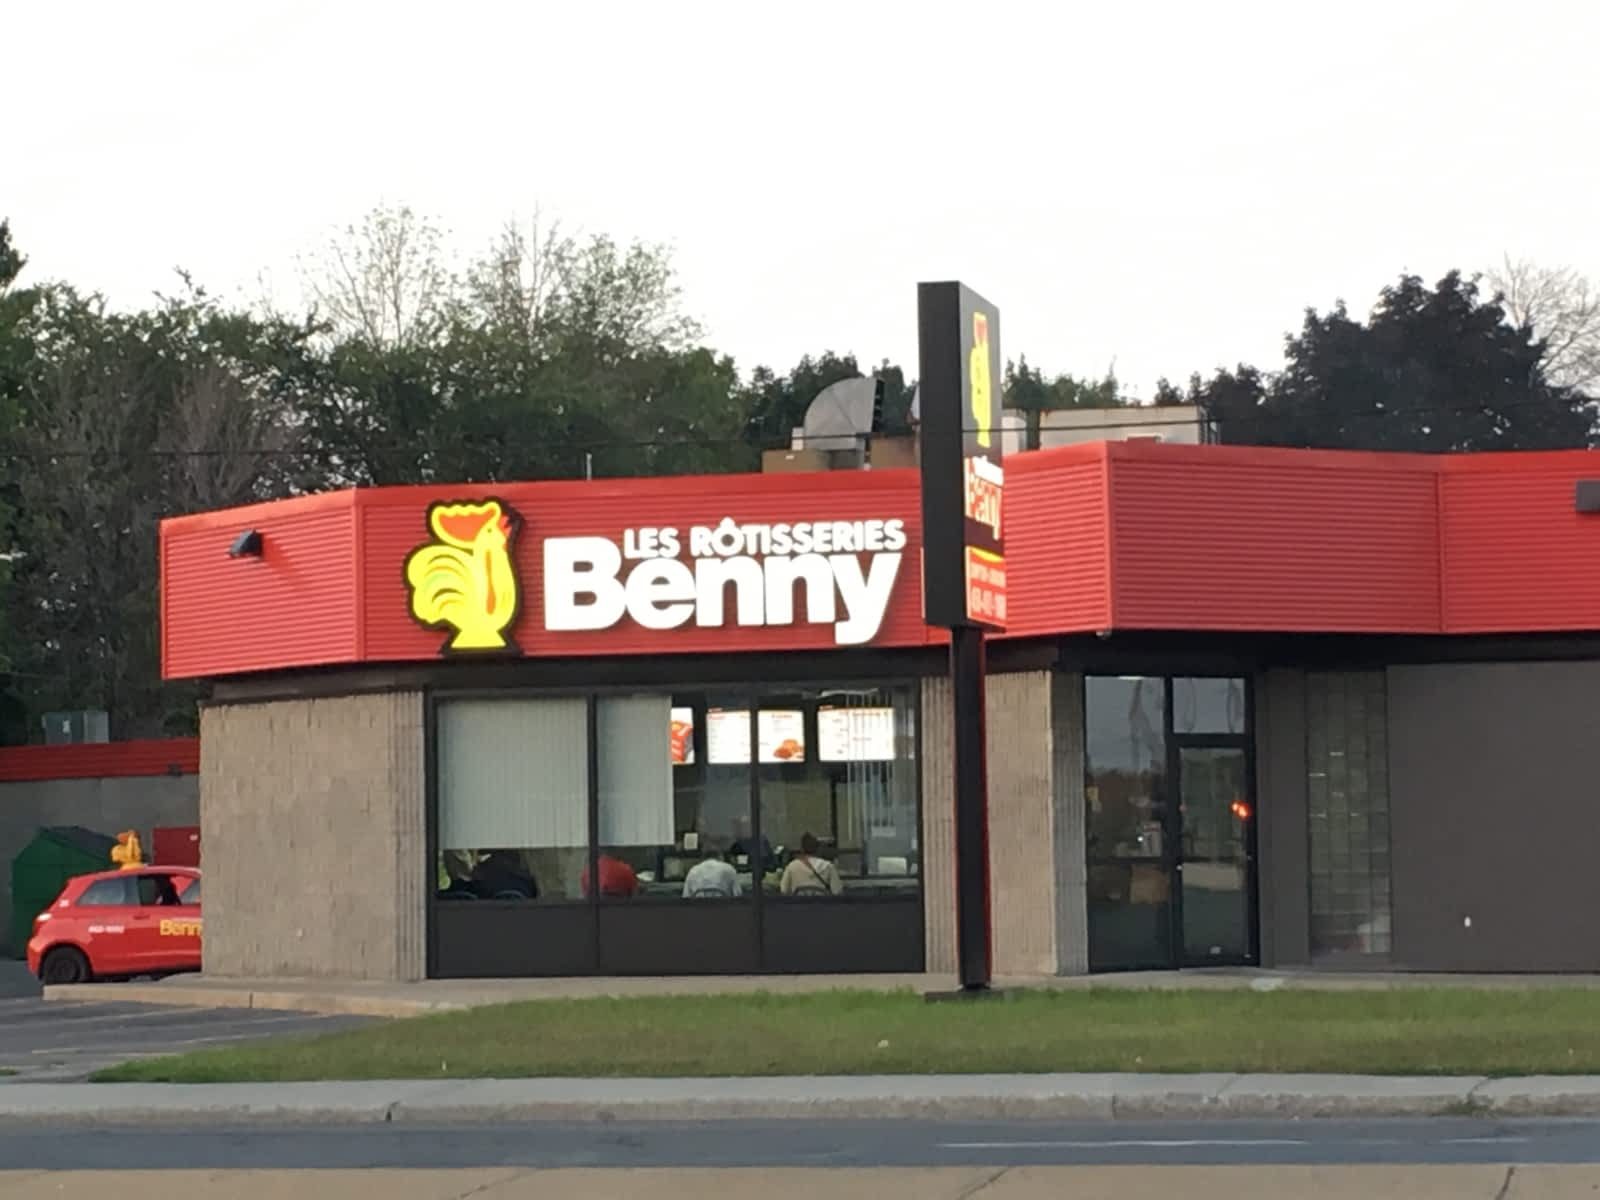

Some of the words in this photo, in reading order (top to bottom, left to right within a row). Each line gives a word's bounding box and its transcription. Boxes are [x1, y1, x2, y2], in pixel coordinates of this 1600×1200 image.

[623, 527, 681, 559] LES
[689, 516, 907, 557] RÔTISSERIES
[543, 536, 902, 645] Benny
[160, 919, 203, 937] Benn
